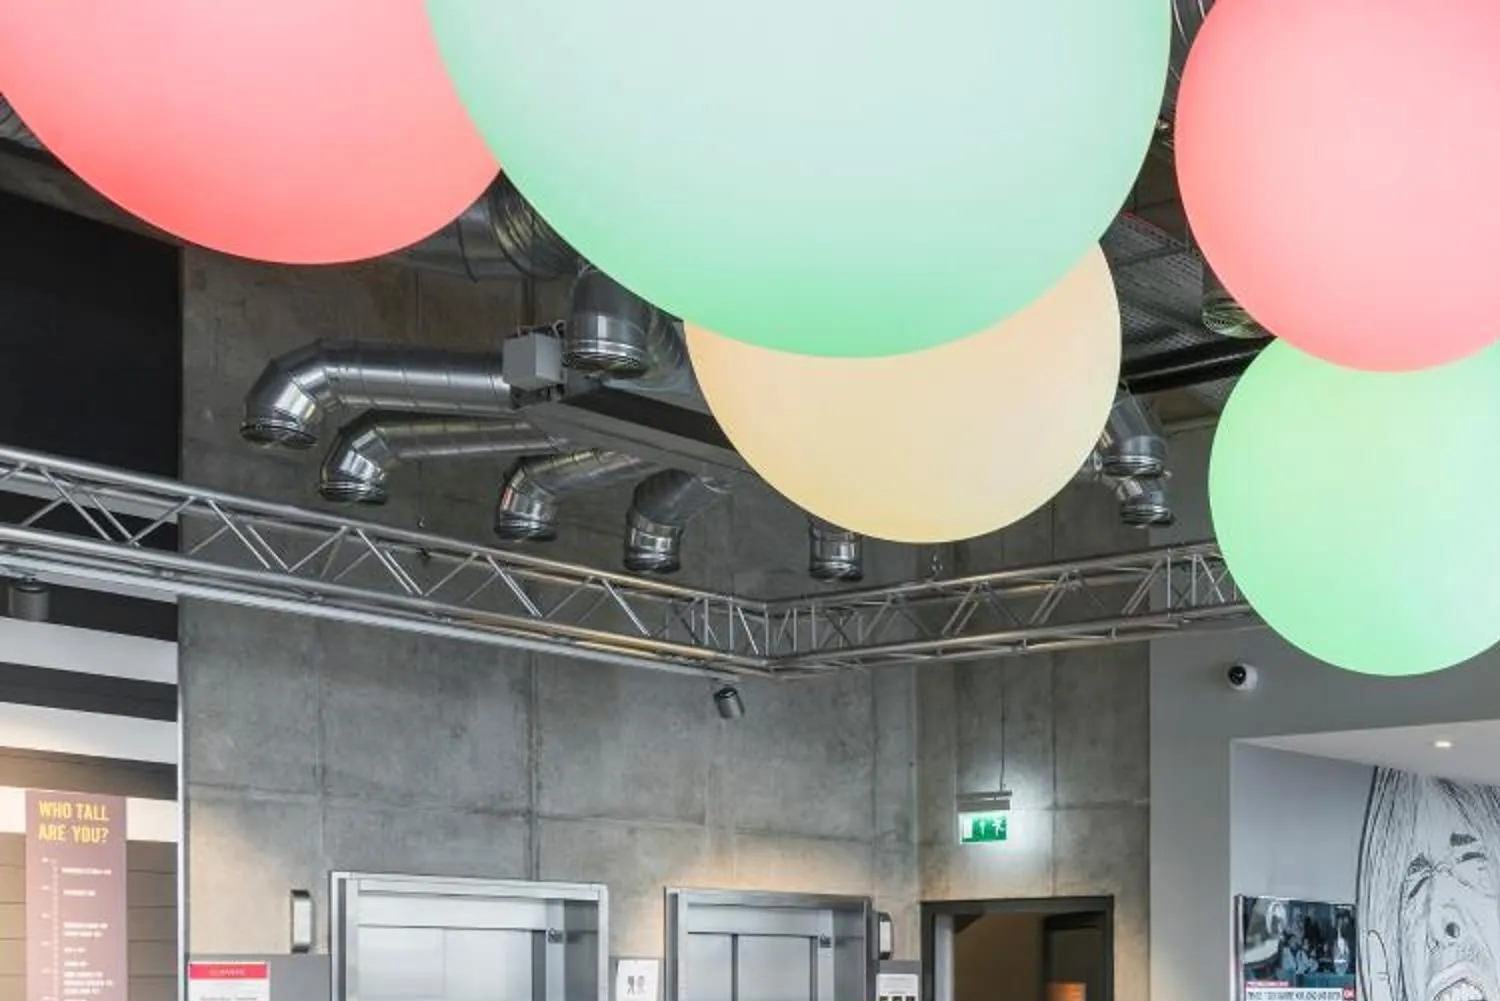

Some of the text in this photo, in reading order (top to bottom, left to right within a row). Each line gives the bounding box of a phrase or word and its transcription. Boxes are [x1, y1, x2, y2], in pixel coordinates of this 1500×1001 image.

[39, 800, 109, 821] WHO TALL
[39, 823, 109, 844] ARE YOU?
